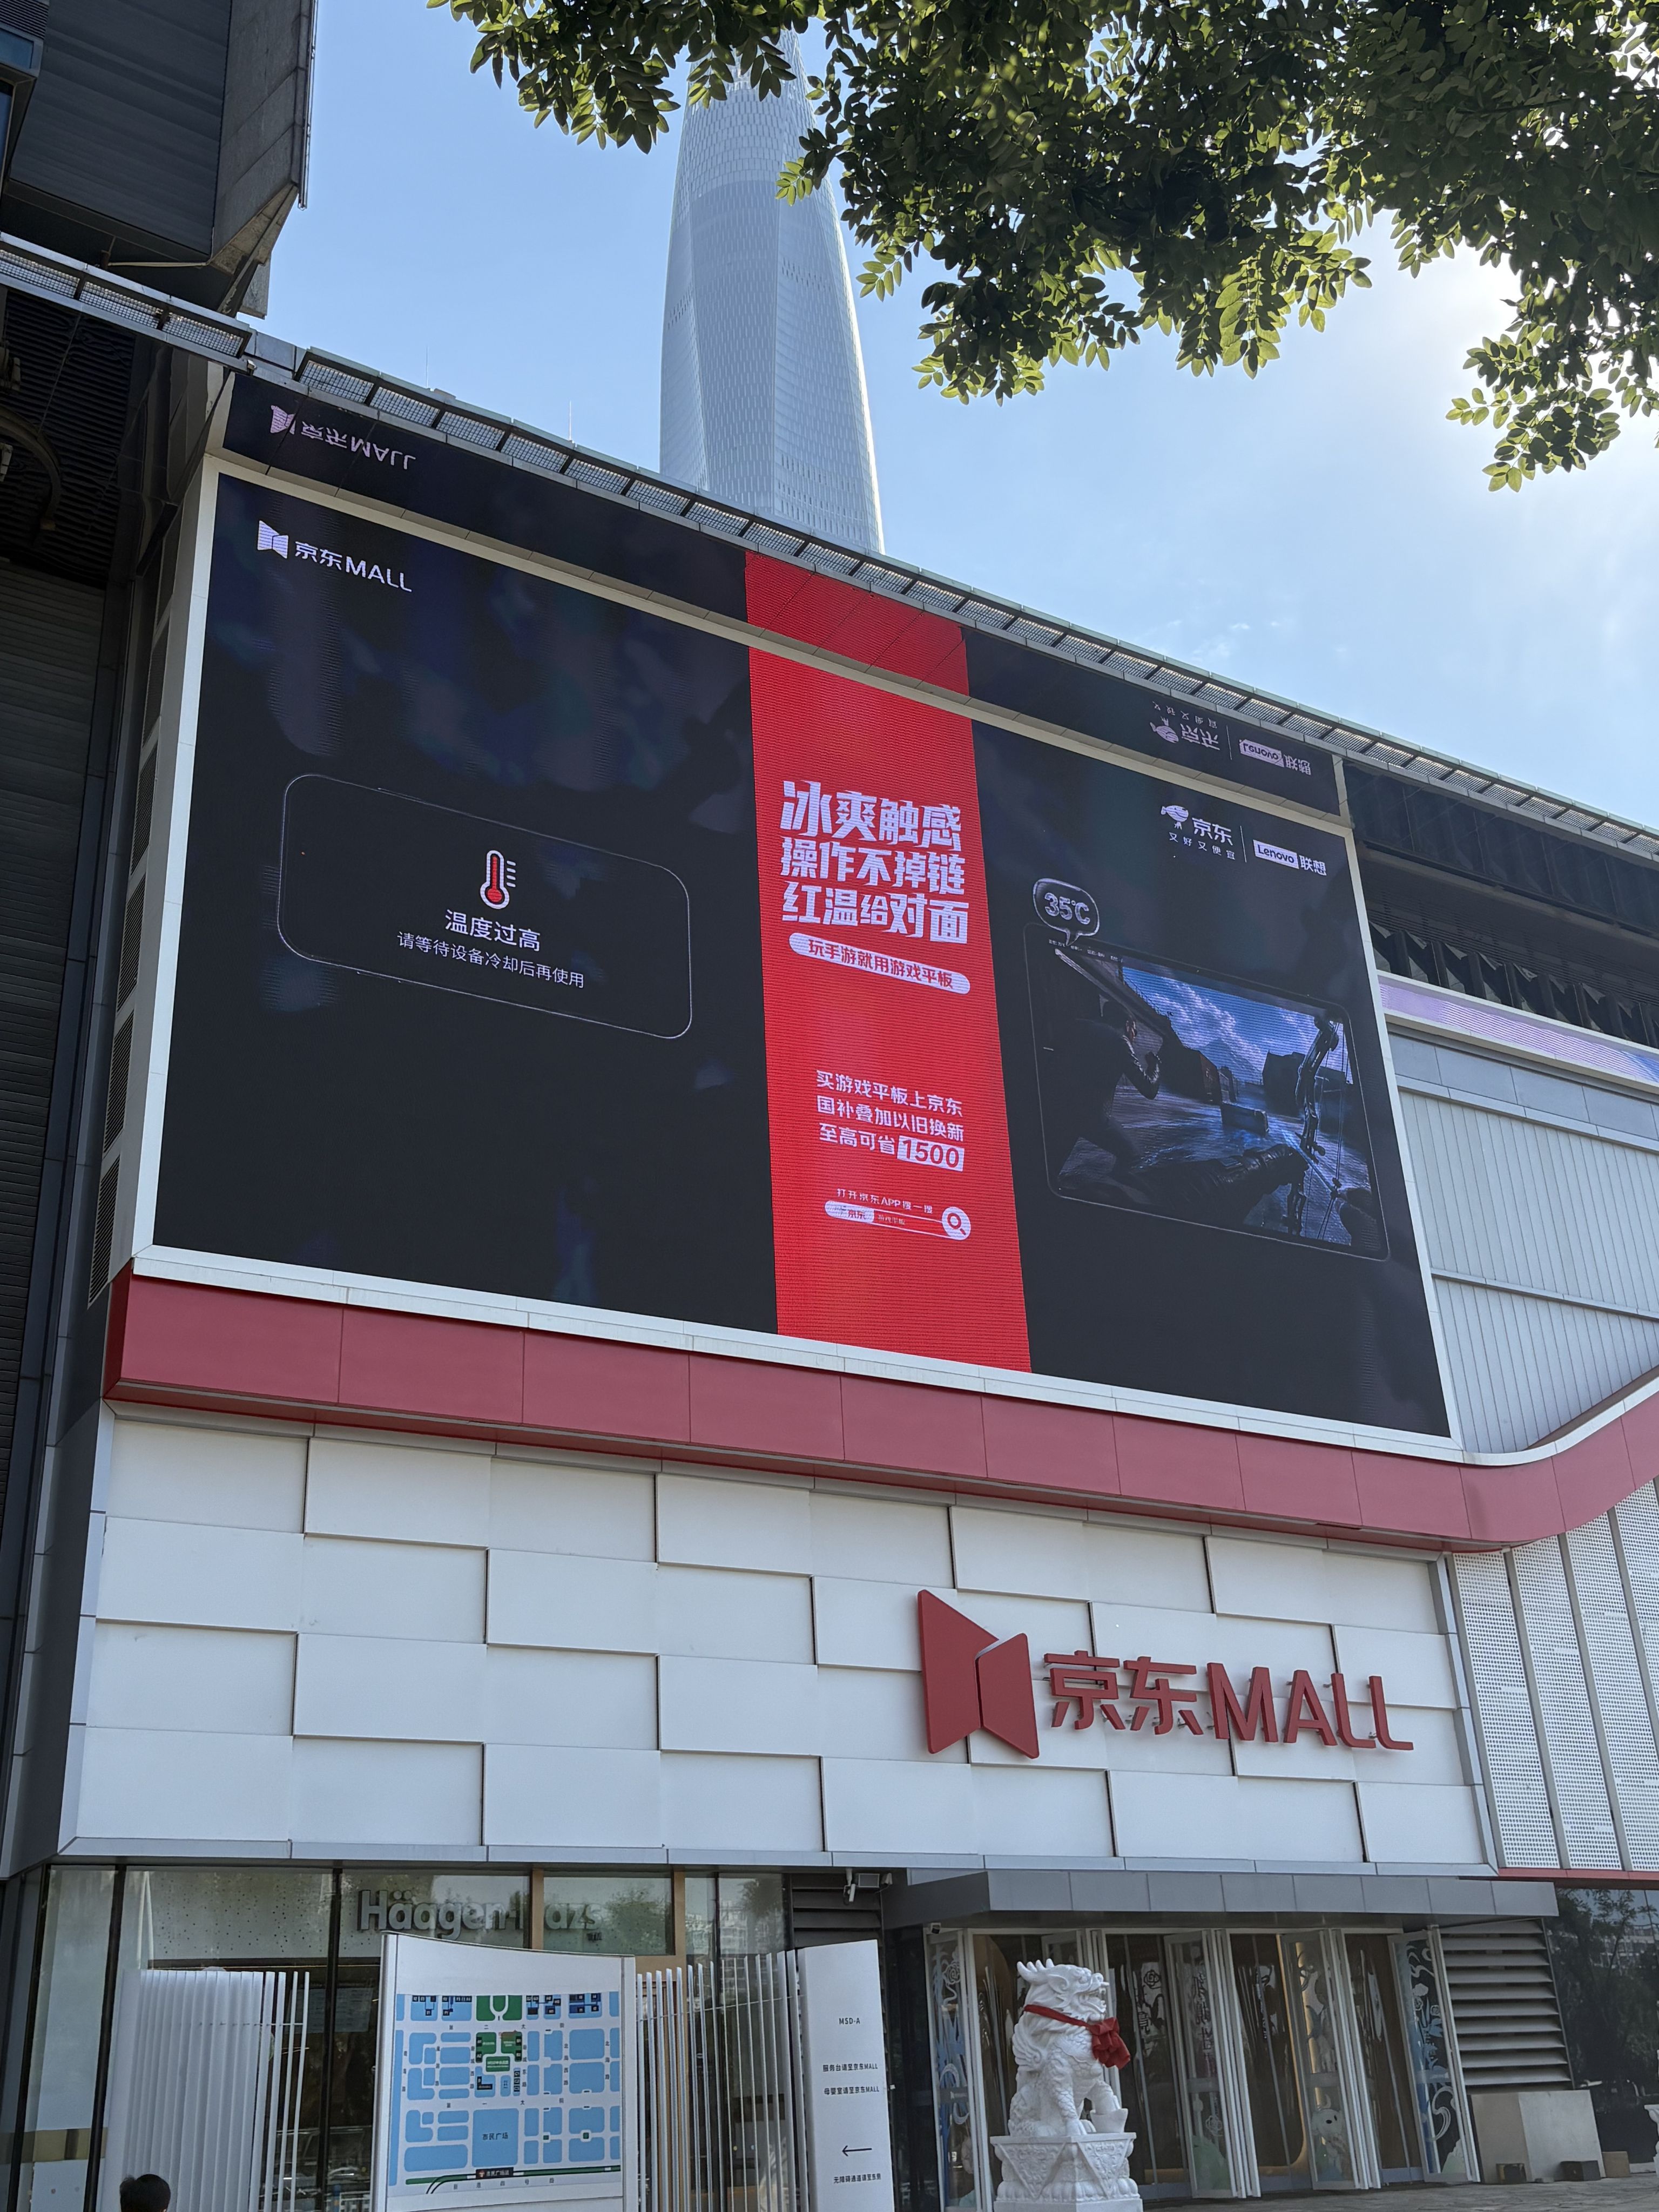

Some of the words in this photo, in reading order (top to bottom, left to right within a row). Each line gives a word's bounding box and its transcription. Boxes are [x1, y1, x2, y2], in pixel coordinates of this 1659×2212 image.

[295, 541, 412, 592] 京东MALL
[780, 780, 961, 851] 冰爽触感
[1191, 817, 1233, 845] 京东
[780, 836, 966, 894] 操作不掉链
[1169, 832, 1236, 861] 又好又便宜
[1258, 845, 1294, 864] Lenovo
[1299, 855, 1326, 876] 联想
[445, 909, 541, 952] 温度过高
[783, 881, 969, 944] 红温给对面
[1044, 892, 1090, 925] 35°C
[397, 931, 584, 989] 请等待设备冷却后再使用
[808, 939, 953, 989] 玩手游就用游戏平板
[817, 1070, 963, 1117] 买游戏平板上京东
[817, 1096, 964, 1141] 国补叠加以旧换新
[1044, 1650, 1414, 1751] 京东MALL
[358, 1890, 603, 1941] Häagen-azs
